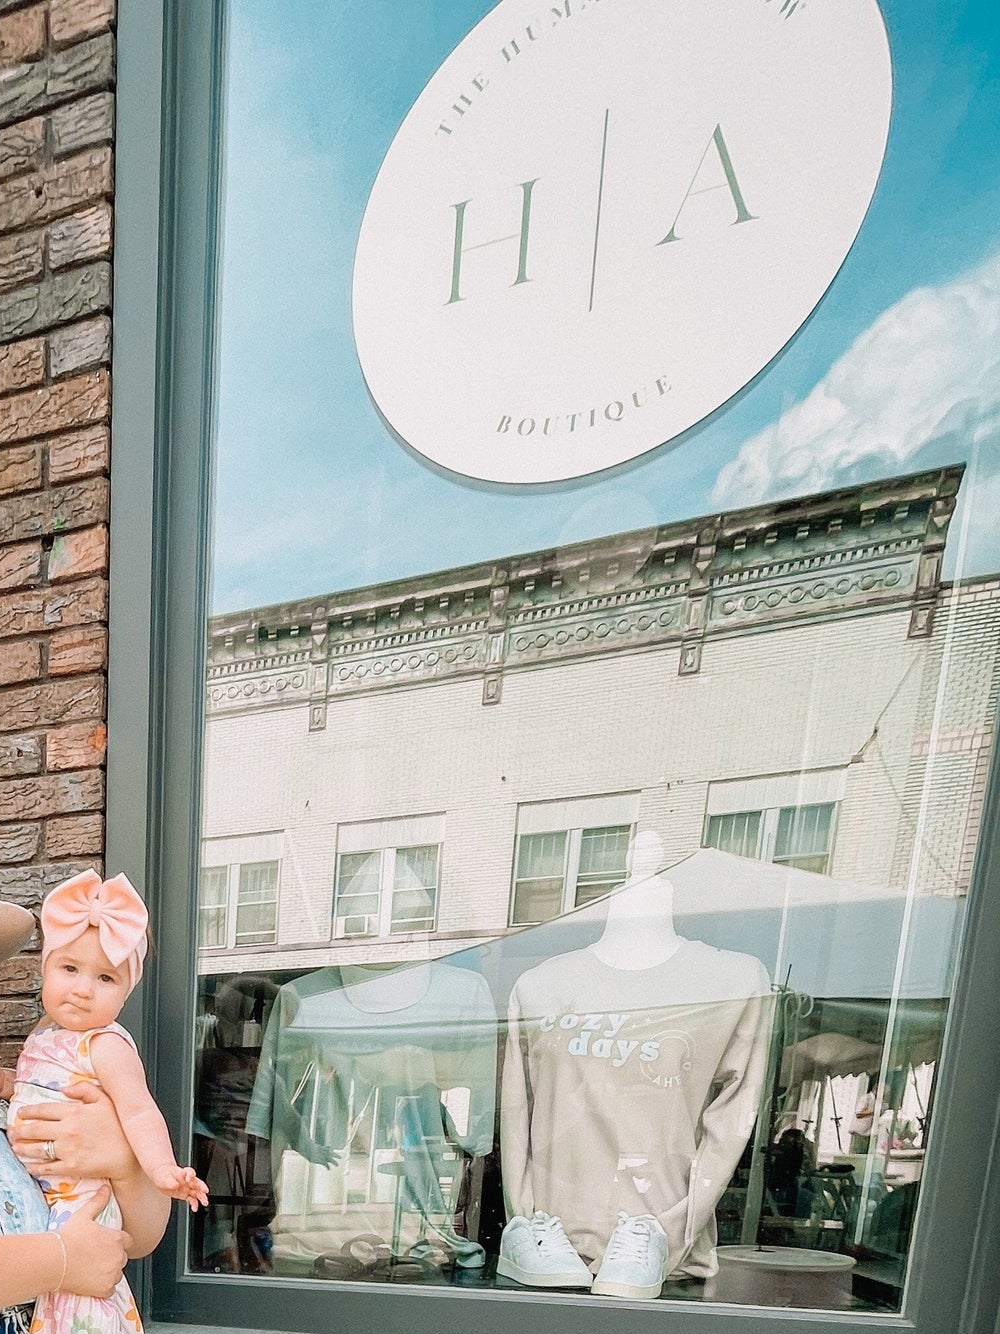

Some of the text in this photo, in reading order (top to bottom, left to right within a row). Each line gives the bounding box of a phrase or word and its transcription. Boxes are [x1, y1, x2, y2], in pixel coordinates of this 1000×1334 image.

[435, 73, 490, 135] THE
[495, 374, 673, 437] BOUTIQUE
[539, 1013, 631, 1038] cozy
[567, 1031, 661, 1068] days
